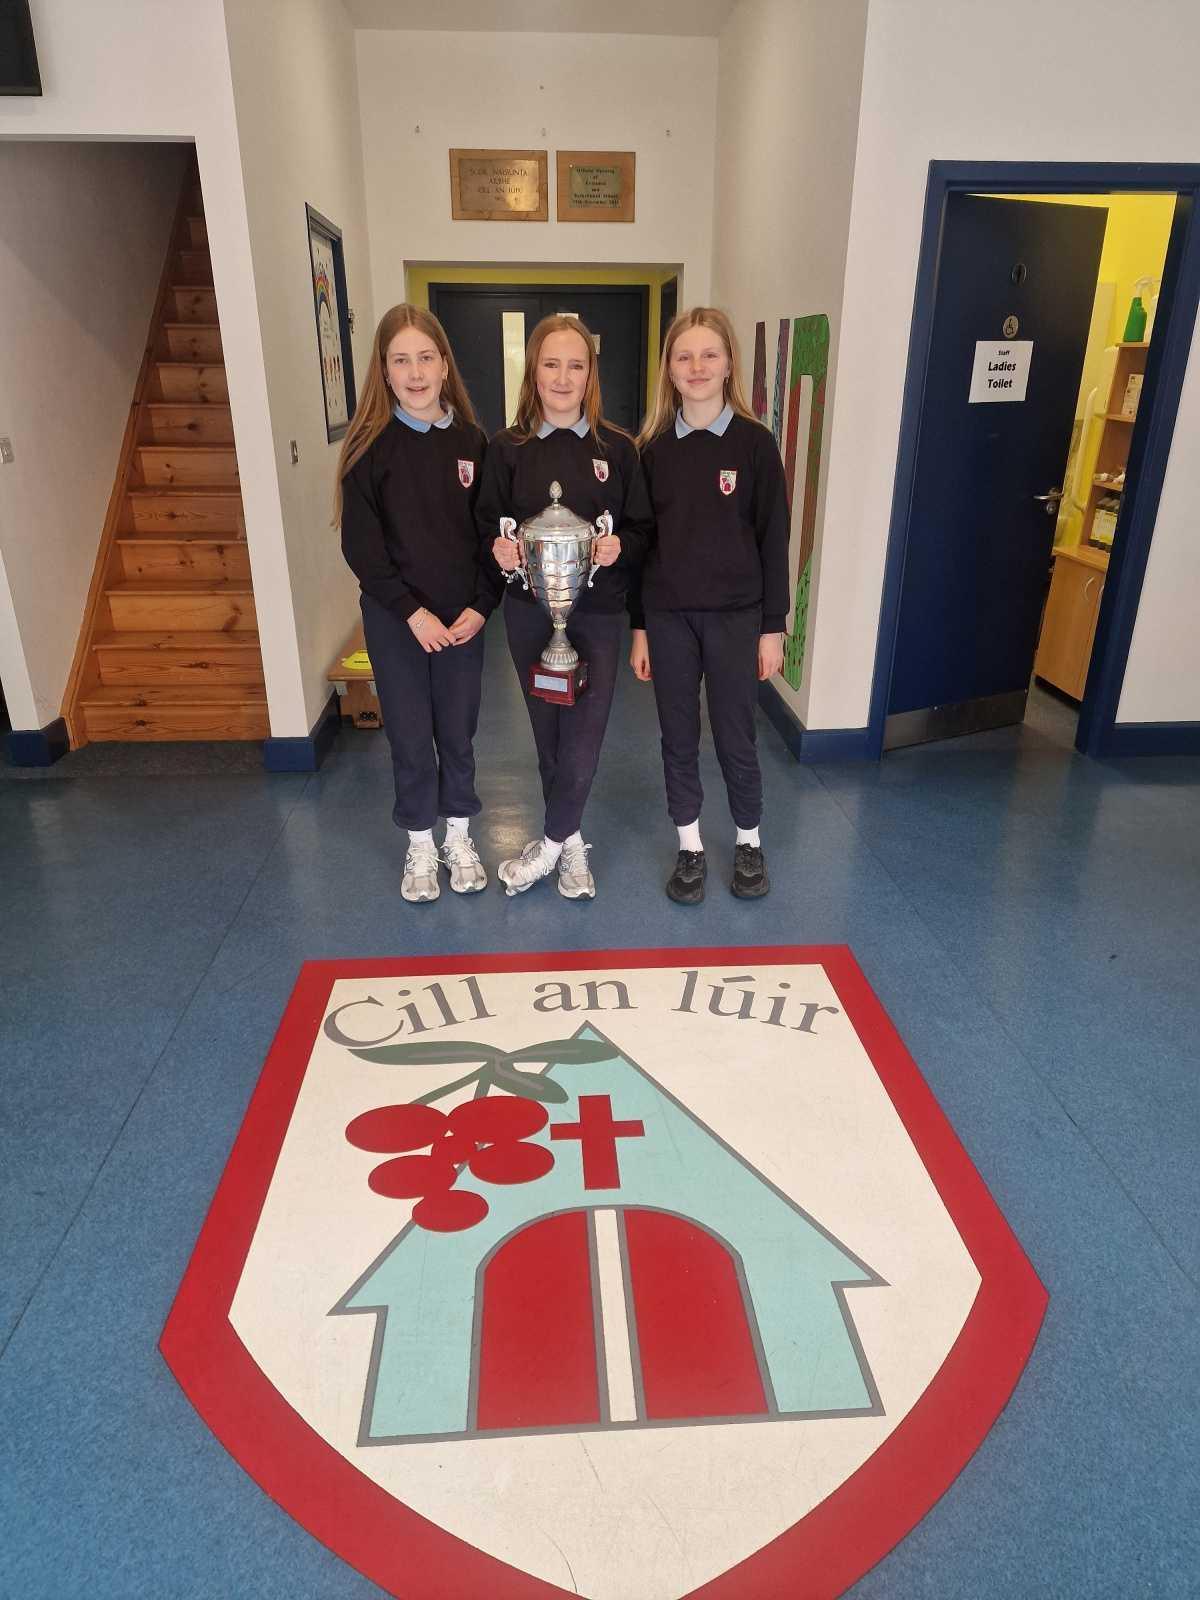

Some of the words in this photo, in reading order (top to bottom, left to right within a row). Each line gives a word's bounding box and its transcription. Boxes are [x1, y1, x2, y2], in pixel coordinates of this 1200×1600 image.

[988, 361, 1016, 372] Ladies
[988, 379, 1012, 388] Toilet
[323, 975, 497, 1047] Cill
[532, 979, 639, 1013] an
